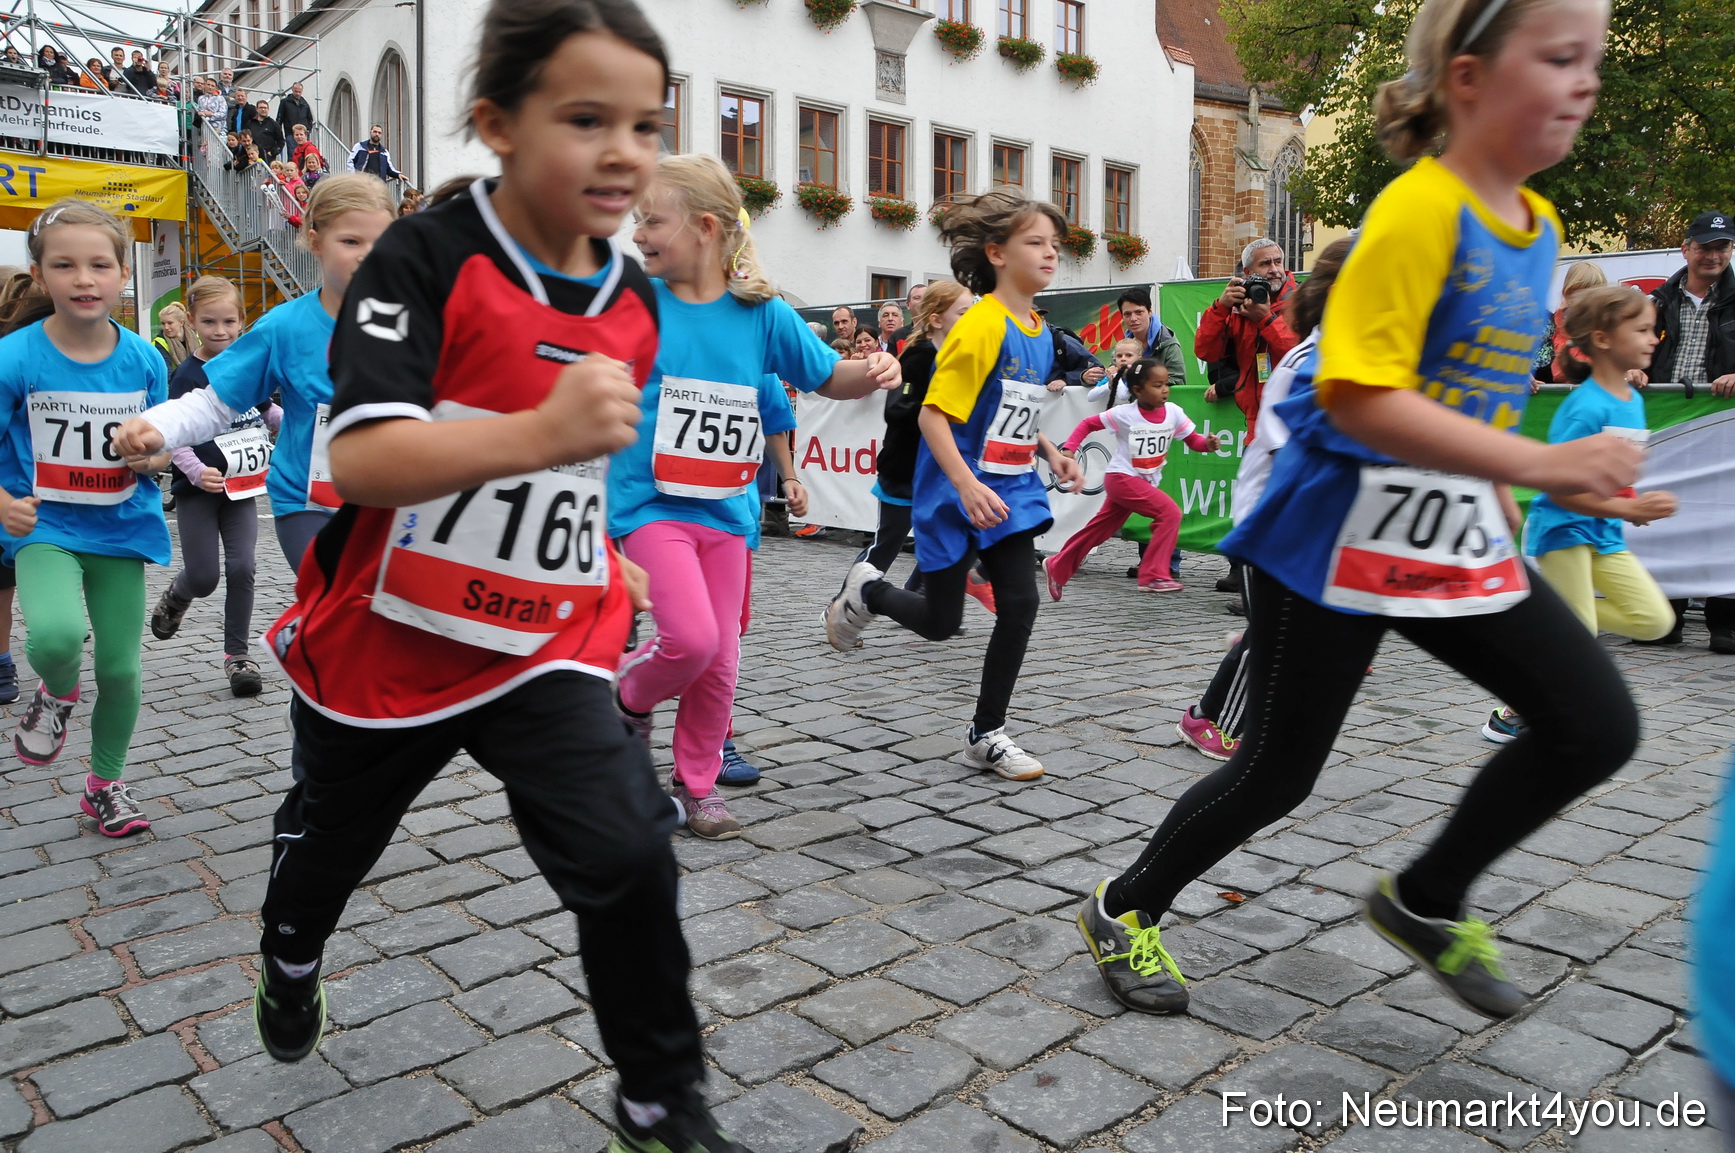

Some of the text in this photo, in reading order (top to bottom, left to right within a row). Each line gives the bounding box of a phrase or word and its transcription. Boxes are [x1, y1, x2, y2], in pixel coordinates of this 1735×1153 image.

[74, 188, 164, 204] Neumarkter Stadtlauf
[31, 402, 137, 415] PARTL Neumarkt
[664, 388, 706, 403] PARTL
[45, 417, 122, 462] 718
[219, 440, 242, 450] PARTL
[673, 407, 759, 457] 7557
[800, 435, 885, 475] Aud
[69, 471, 124, 488] Melina
[1180, 477, 1237, 519] Wil
[462, 579, 551, 625] Sarah
